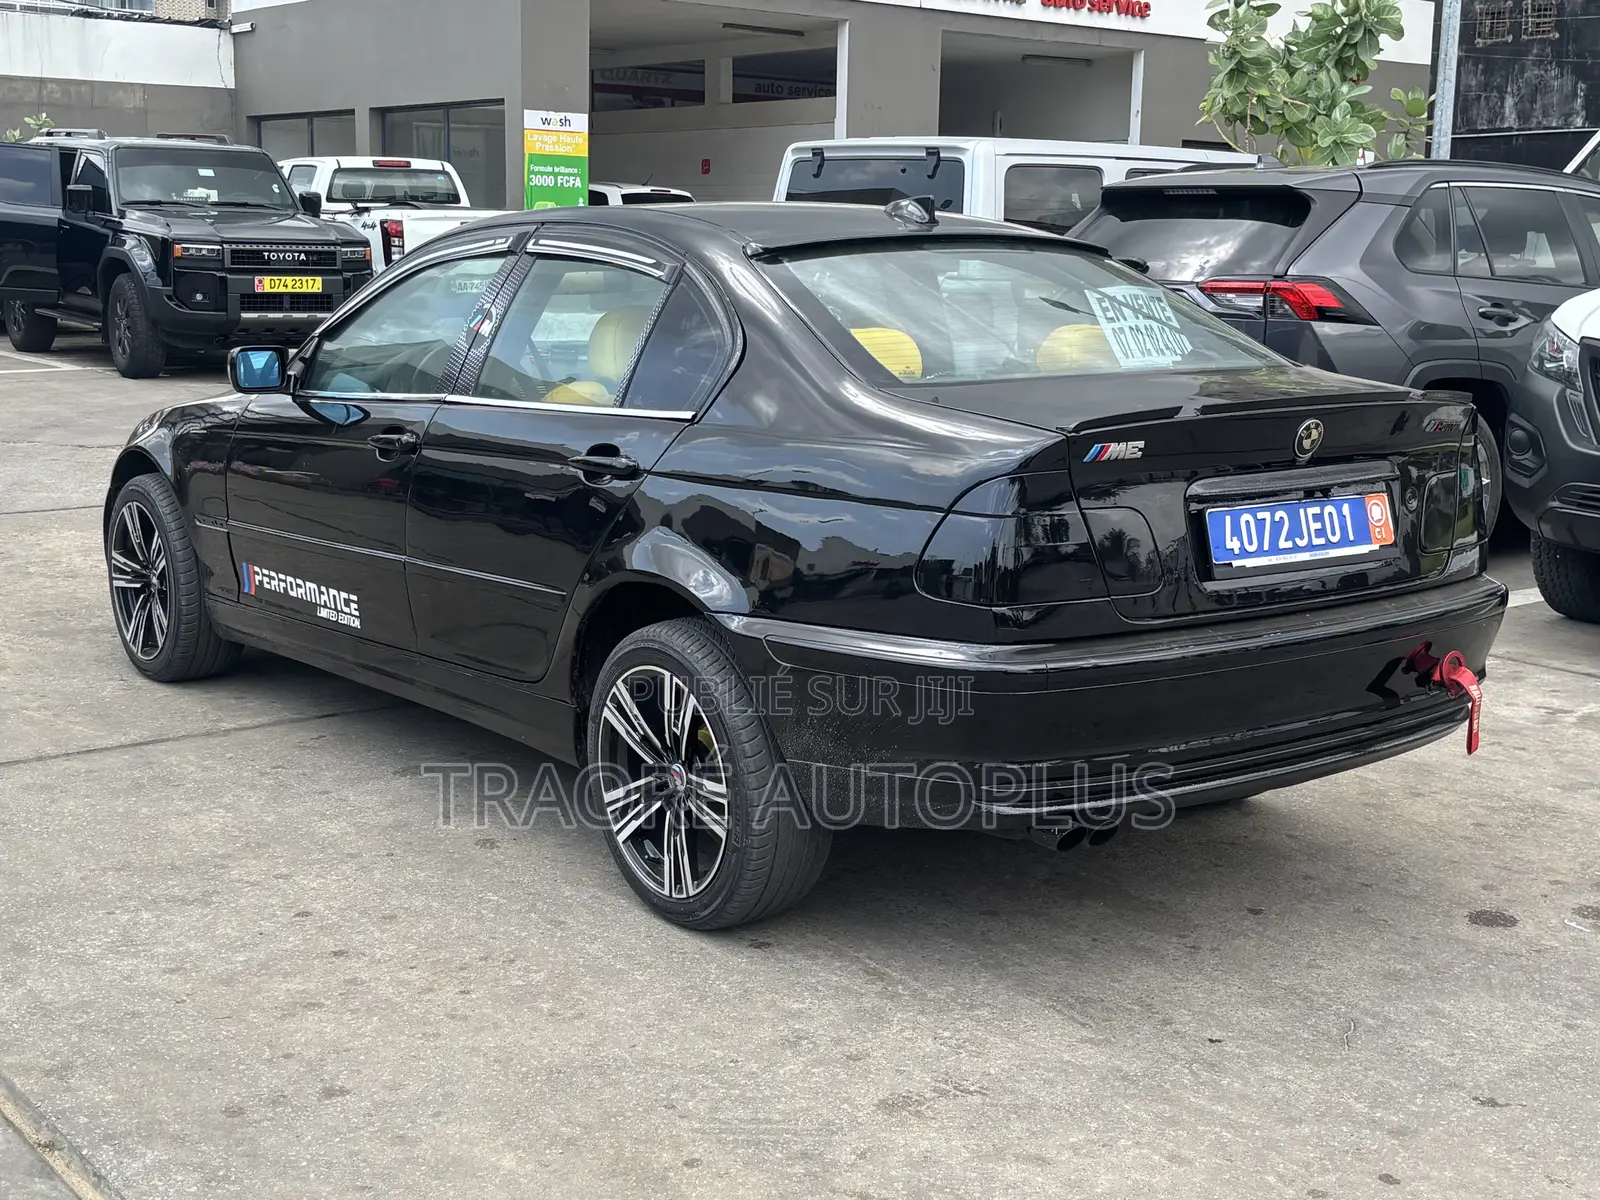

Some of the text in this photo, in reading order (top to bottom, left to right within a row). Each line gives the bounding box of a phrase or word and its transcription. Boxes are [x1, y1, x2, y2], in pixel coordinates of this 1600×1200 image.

[754, 82, 832, 97] auto service
[541, 116, 571, 127] wash
[527, 132, 583, 143] Lavage Haute
[530, 164, 554, 173] Formule
[553, 166, 578, 174] brillance
[529, 174, 582, 188] 3000 FCFA
[262, 252, 307, 261] TOYOTA
[269, 278, 289, 290] D74
[1096, 293, 1173, 324] EN VENTE
[1225, 503, 1354, 554] 4072JE01
[1374, 527, 1386, 540] CI
[254, 565, 359, 616] PERFORMANCE
[317, 606, 361, 629] LIMITED EDITION
